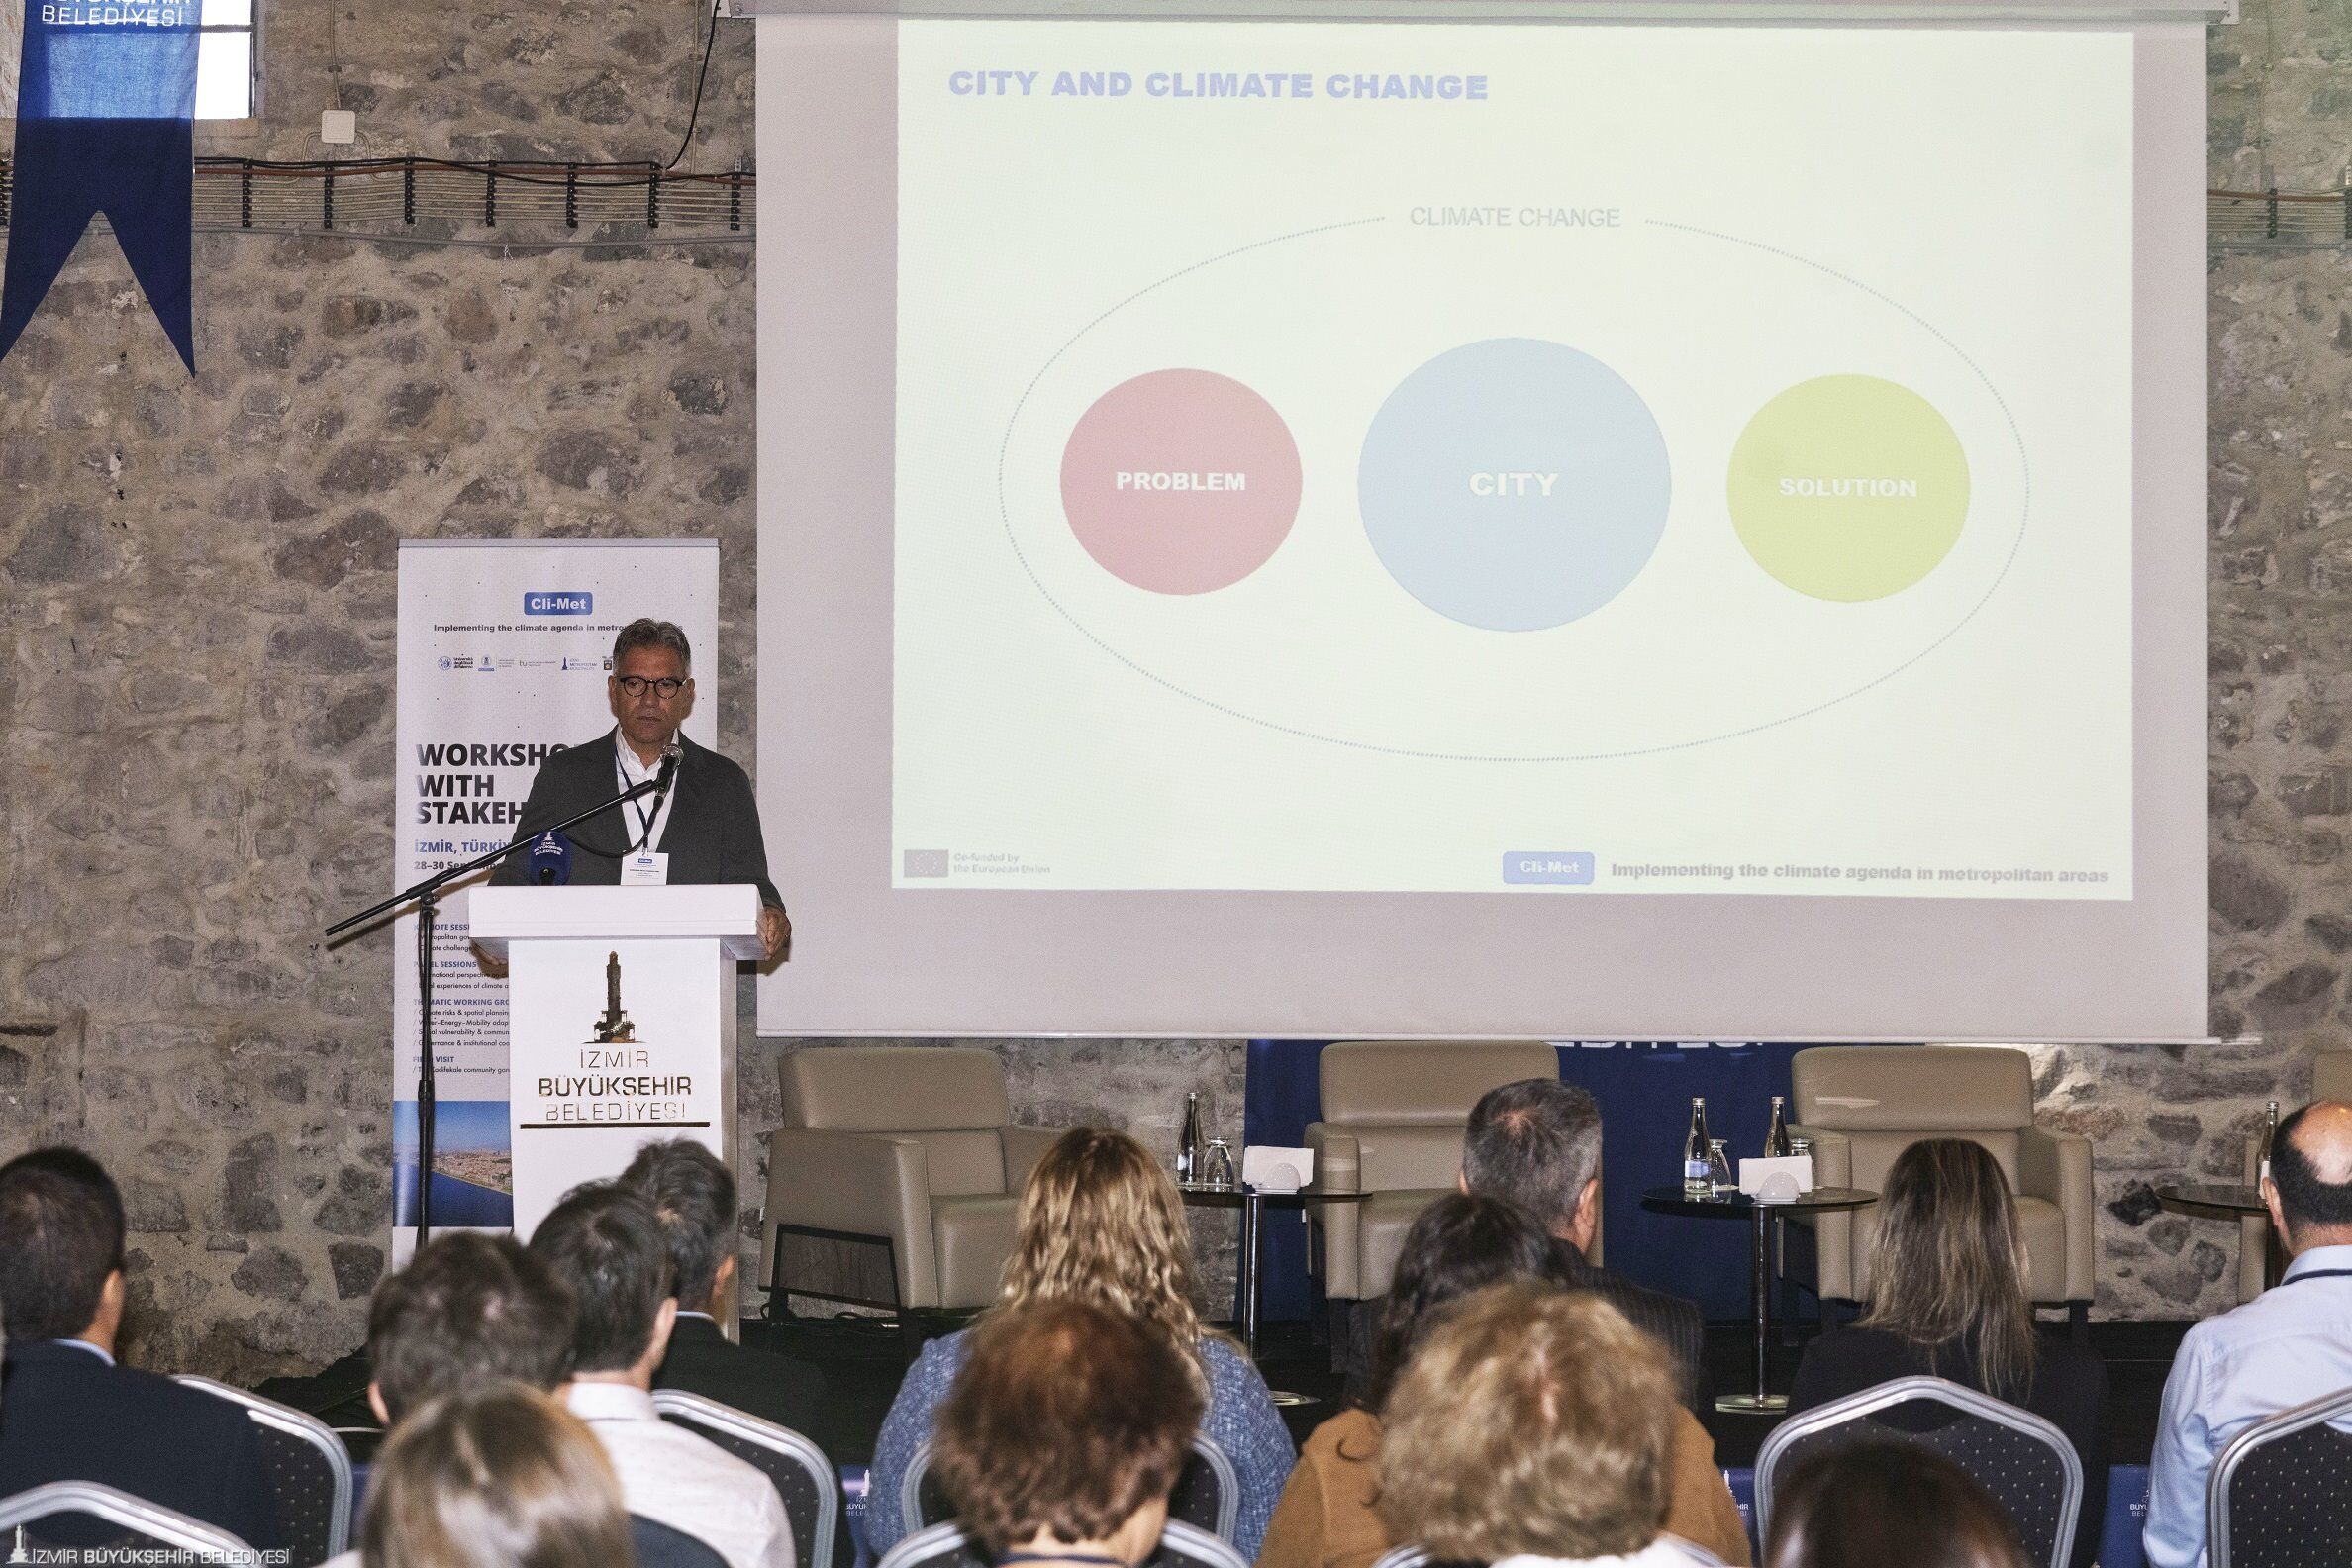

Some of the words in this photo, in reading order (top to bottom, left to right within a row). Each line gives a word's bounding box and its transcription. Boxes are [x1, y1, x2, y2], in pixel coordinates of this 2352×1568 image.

[948, 70, 1039, 96] CITY
[1051, 71, 1132, 97] AND
[1144, 72, 1314, 98] CLIMATE
[1326, 74, 1488, 100] CHANGE
[1410, 206, 1512, 227] CLIMATE
[1519, 208, 1621, 228] CHANGE
[1116, 471, 1246, 492] PROBLEM
[1469, 472, 1559, 496] CITY
[1780, 478, 1918, 497] SOLUTION
[531, 598, 587, 611] Cli-Met
[434, 624, 495, 633] Implementing
[550, 624, 584, 633] agenda
[416, 775, 494, 797] WITH
[416, 801, 528, 825] STAKEH
[415, 839, 457, 854] İZMİR,
[953, 853, 1005, 862] Co-funded
[1008, 853, 1020, 864] by
[1519, 860, 1580, 873] Cli-Met
[972, 865, 1019, 875] European
[1022, 865, 1050, 874] Union
[1612, 863, 1733, 880] Implementing
[1739, 863, 1768, 877] the
[1774, 864, 1841, 879] climate
[1846, 866, 1911, 881] agenda
[1917, 866, 1932, 881] in
[1938, 867, 2053, 884] metropolitan
[2058, 870, 2109, 883] areas
